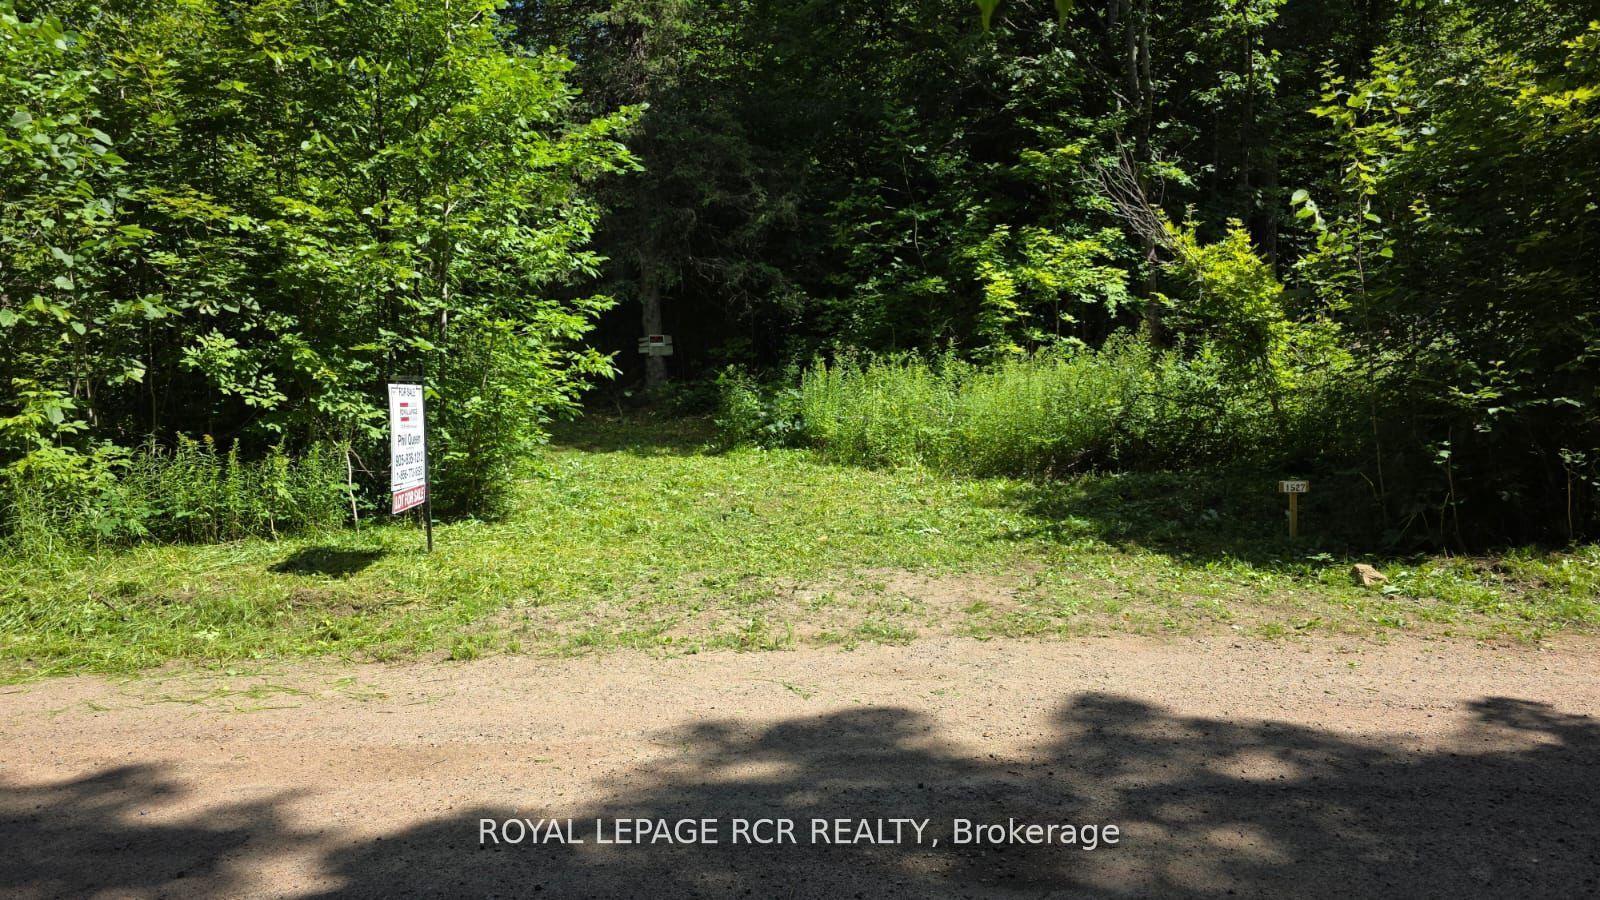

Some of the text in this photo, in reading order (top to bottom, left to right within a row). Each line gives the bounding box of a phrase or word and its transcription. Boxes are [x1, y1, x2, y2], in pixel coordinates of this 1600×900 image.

[1286, 482, 1306, 492] 1527
[394, 487, 425, 510] LOT FOR SALE
